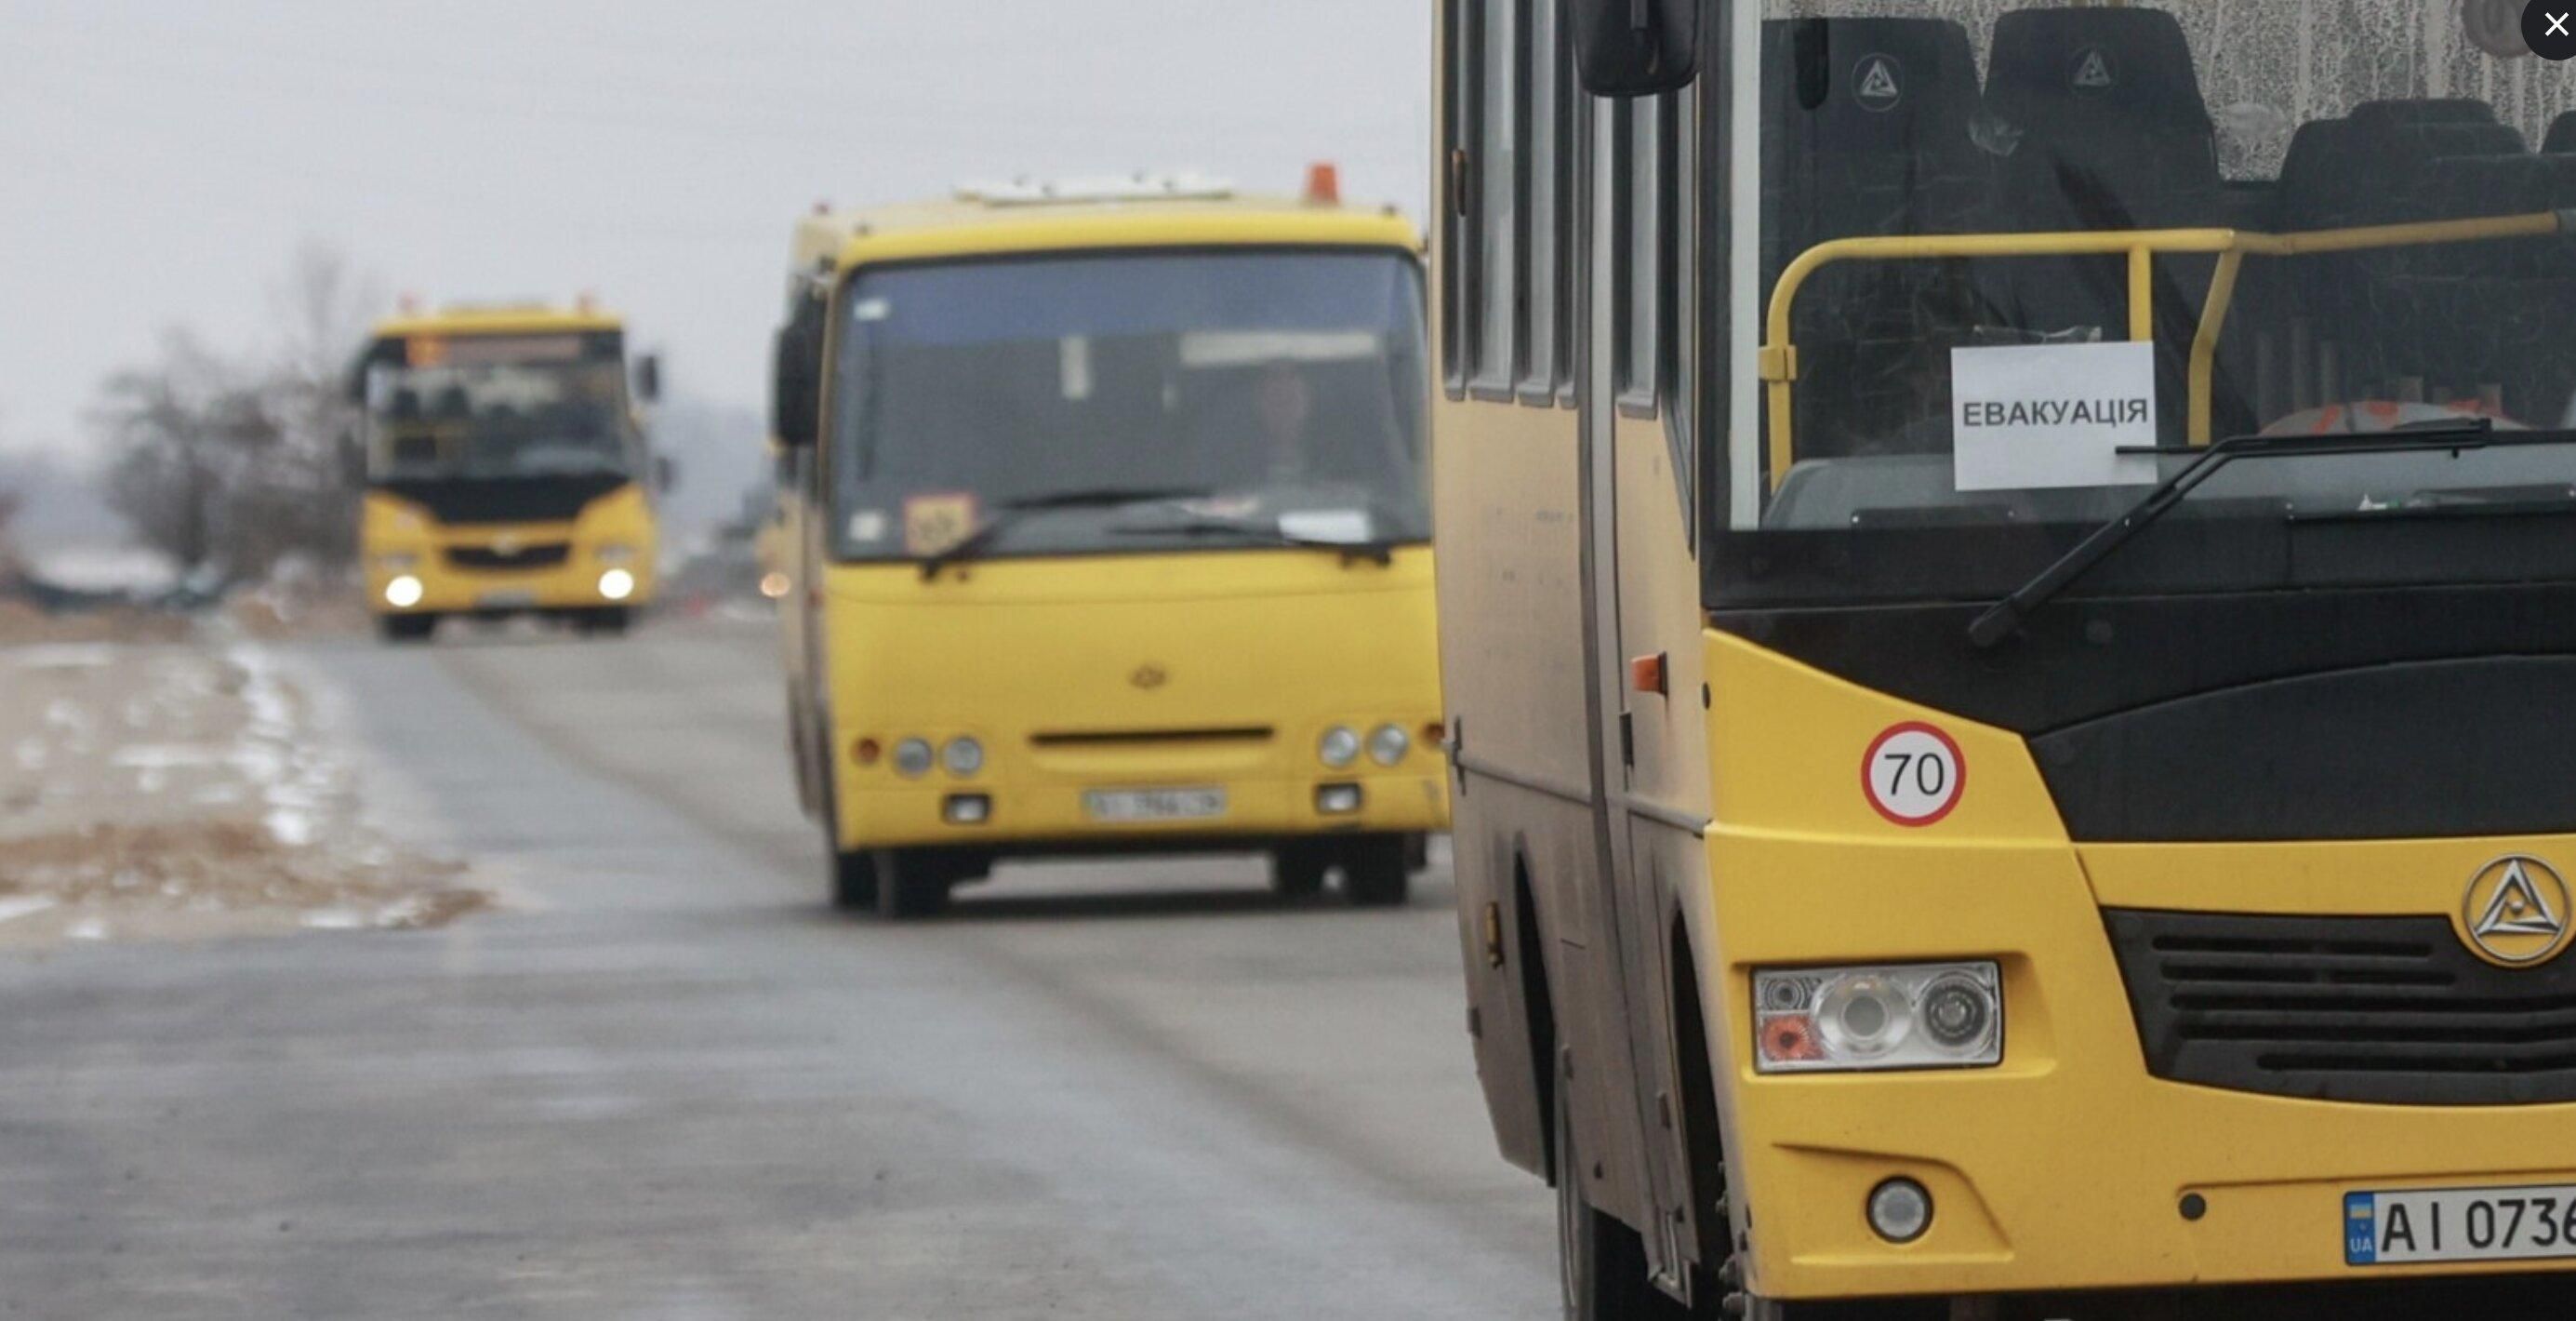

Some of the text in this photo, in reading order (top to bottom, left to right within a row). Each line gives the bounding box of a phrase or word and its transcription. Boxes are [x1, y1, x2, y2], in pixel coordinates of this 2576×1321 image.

[1963, 398, 2148, 428] ЕВАКУАЦІЯ
[1884, 752, 1945, 796] 70
[2350, 1236, 2372, 1252] UA
